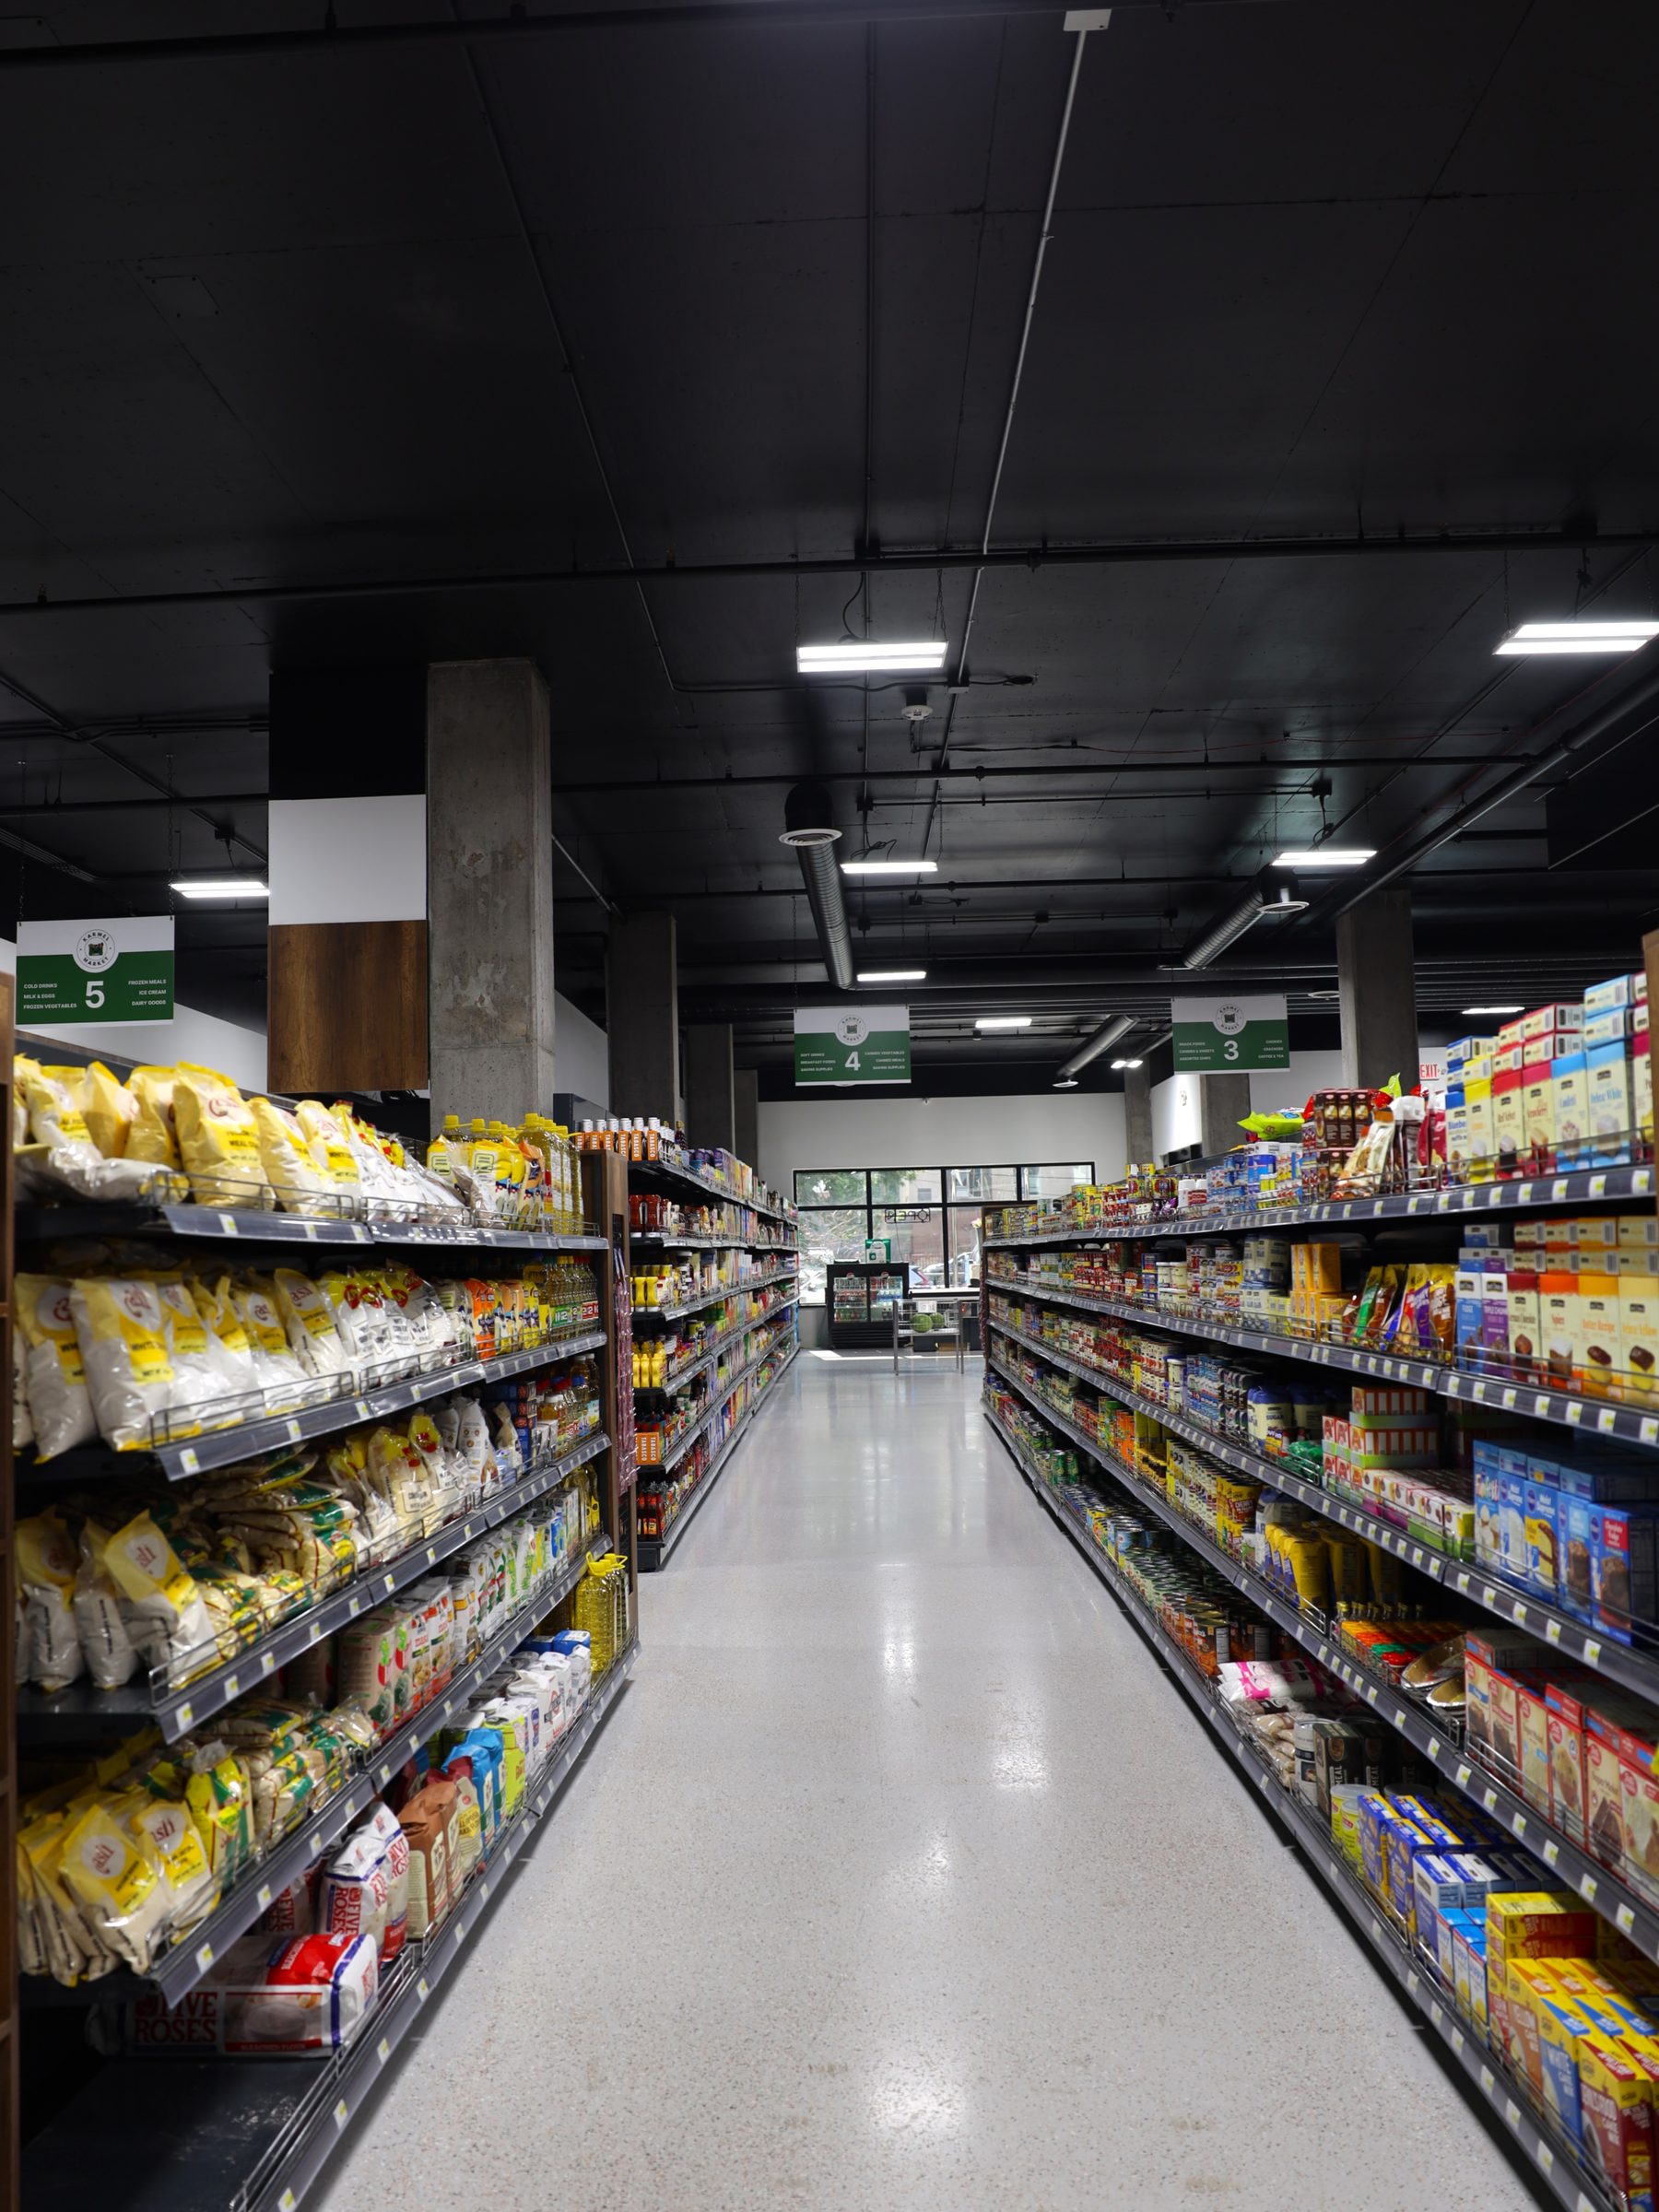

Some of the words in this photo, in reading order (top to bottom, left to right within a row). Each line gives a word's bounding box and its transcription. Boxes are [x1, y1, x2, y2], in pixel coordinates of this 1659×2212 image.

[82, 931, 110, 942] KARMEL
[82, 956, 110, 966] MARKET
[85, 980, 105, 1008] 5
[1223, 1040, 1239, 1061] 3
[844, 1051, 861, 1071] 4
[1419, 1064, 1438, 1077] EXIT
[134, 2018, 218, 2043] ROSES
